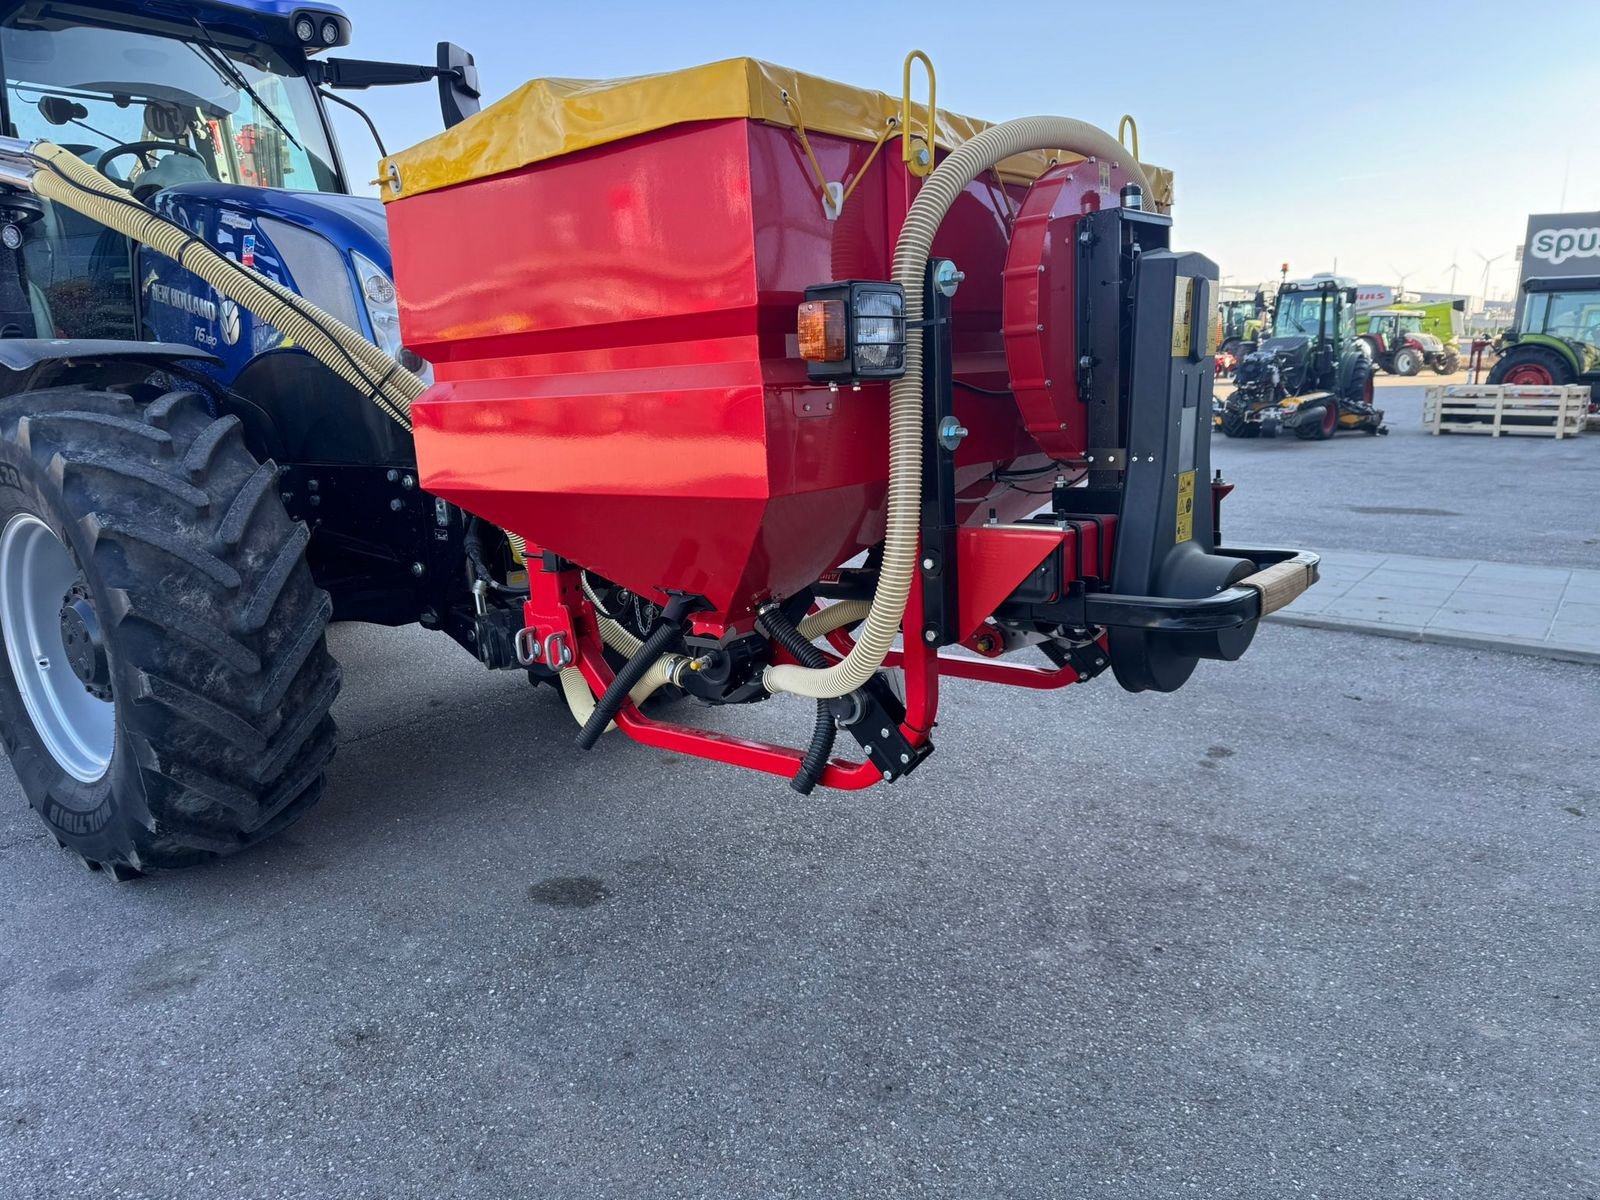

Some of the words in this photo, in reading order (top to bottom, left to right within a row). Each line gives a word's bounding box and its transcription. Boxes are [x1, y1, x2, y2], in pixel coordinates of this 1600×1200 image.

[1535, 232, 1600, 260] spu
[151, 283, 170, 305] NEW
[170, 287, 217, 322] HOLLAND
[194, 326, 218, 346] T6.180
